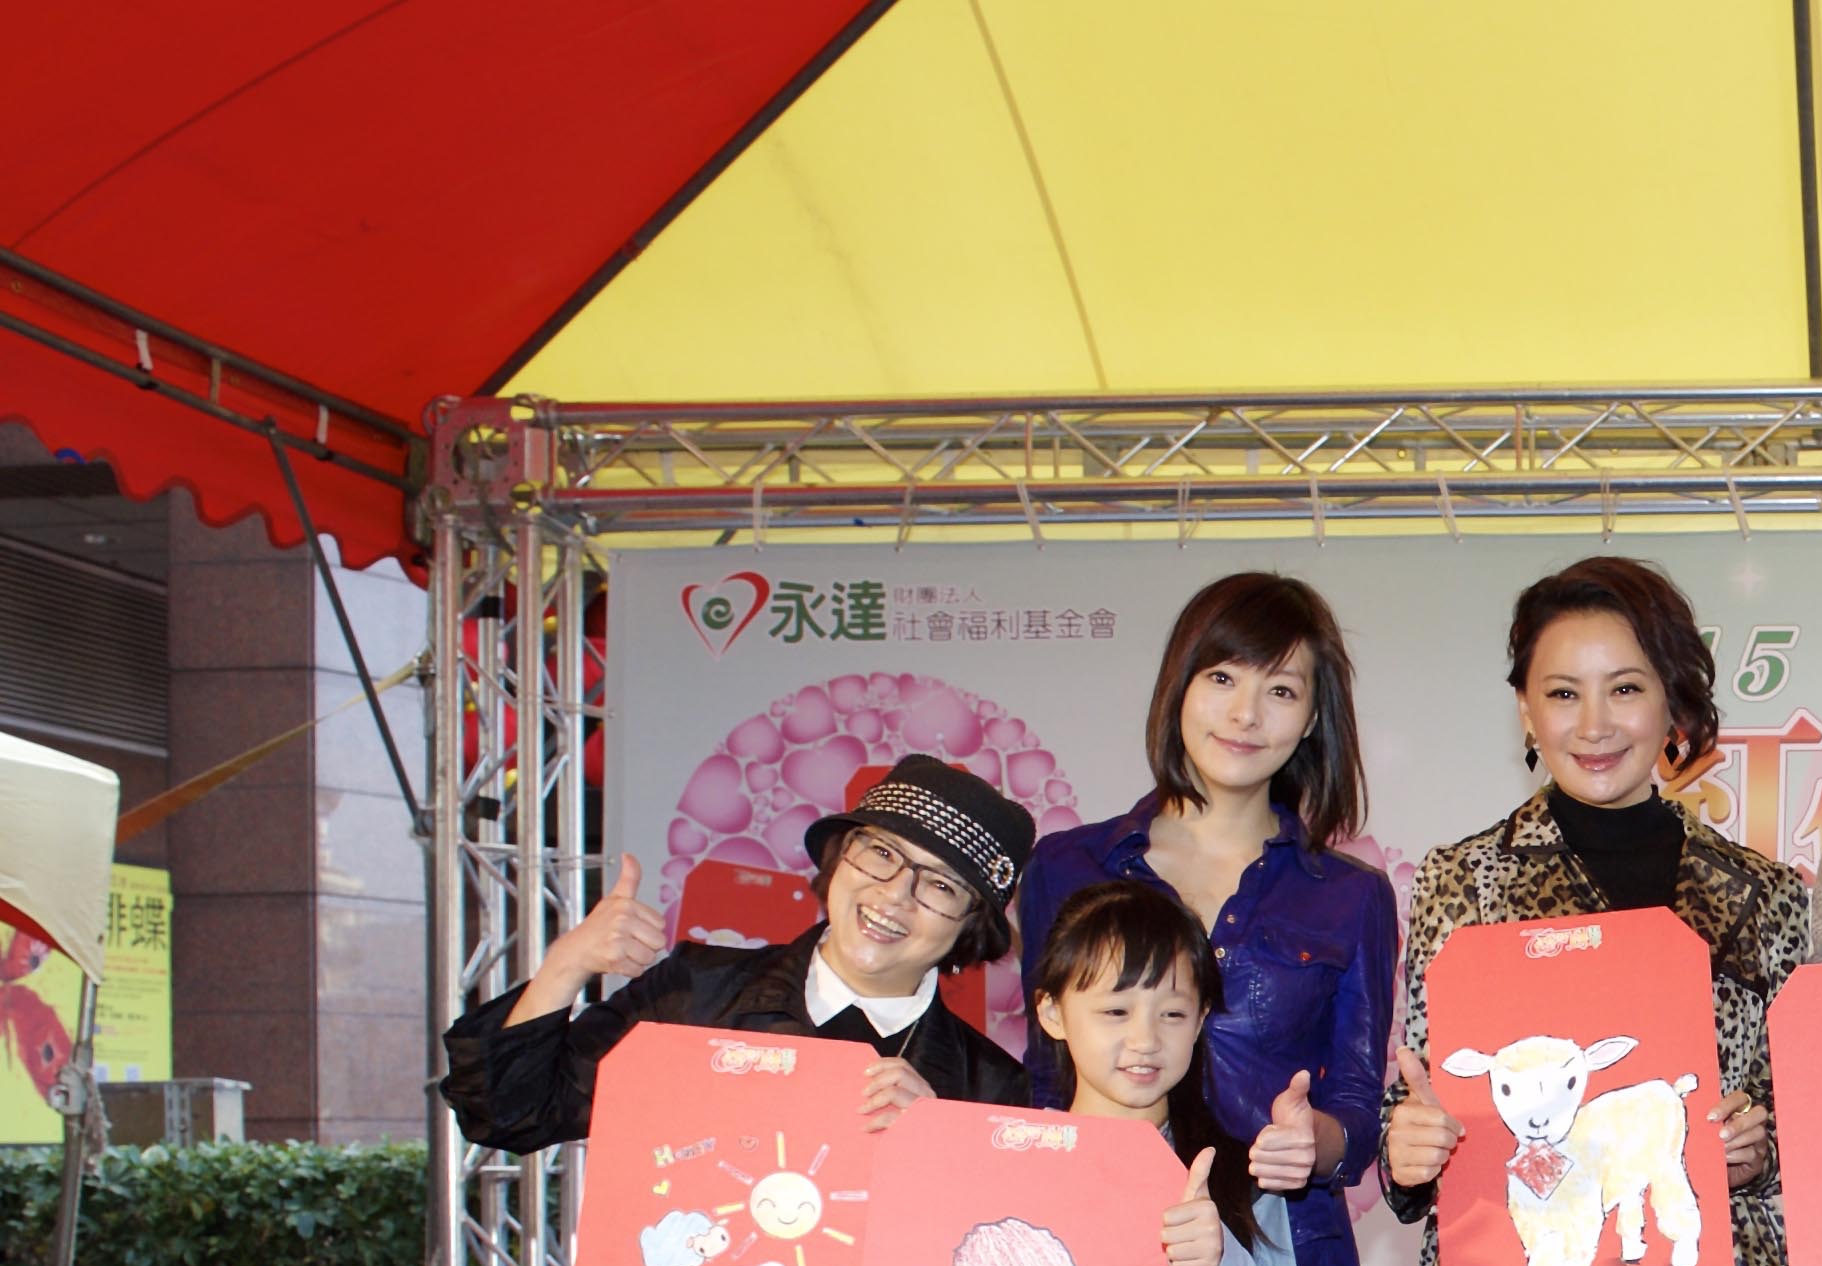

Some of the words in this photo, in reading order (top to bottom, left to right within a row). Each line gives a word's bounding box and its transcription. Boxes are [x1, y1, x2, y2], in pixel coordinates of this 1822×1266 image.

[893, 585, 984, 604] 財團法人
[769, 581, 886, 643] 永達
[893, 608, 1118, 641] 社會福利基金會
